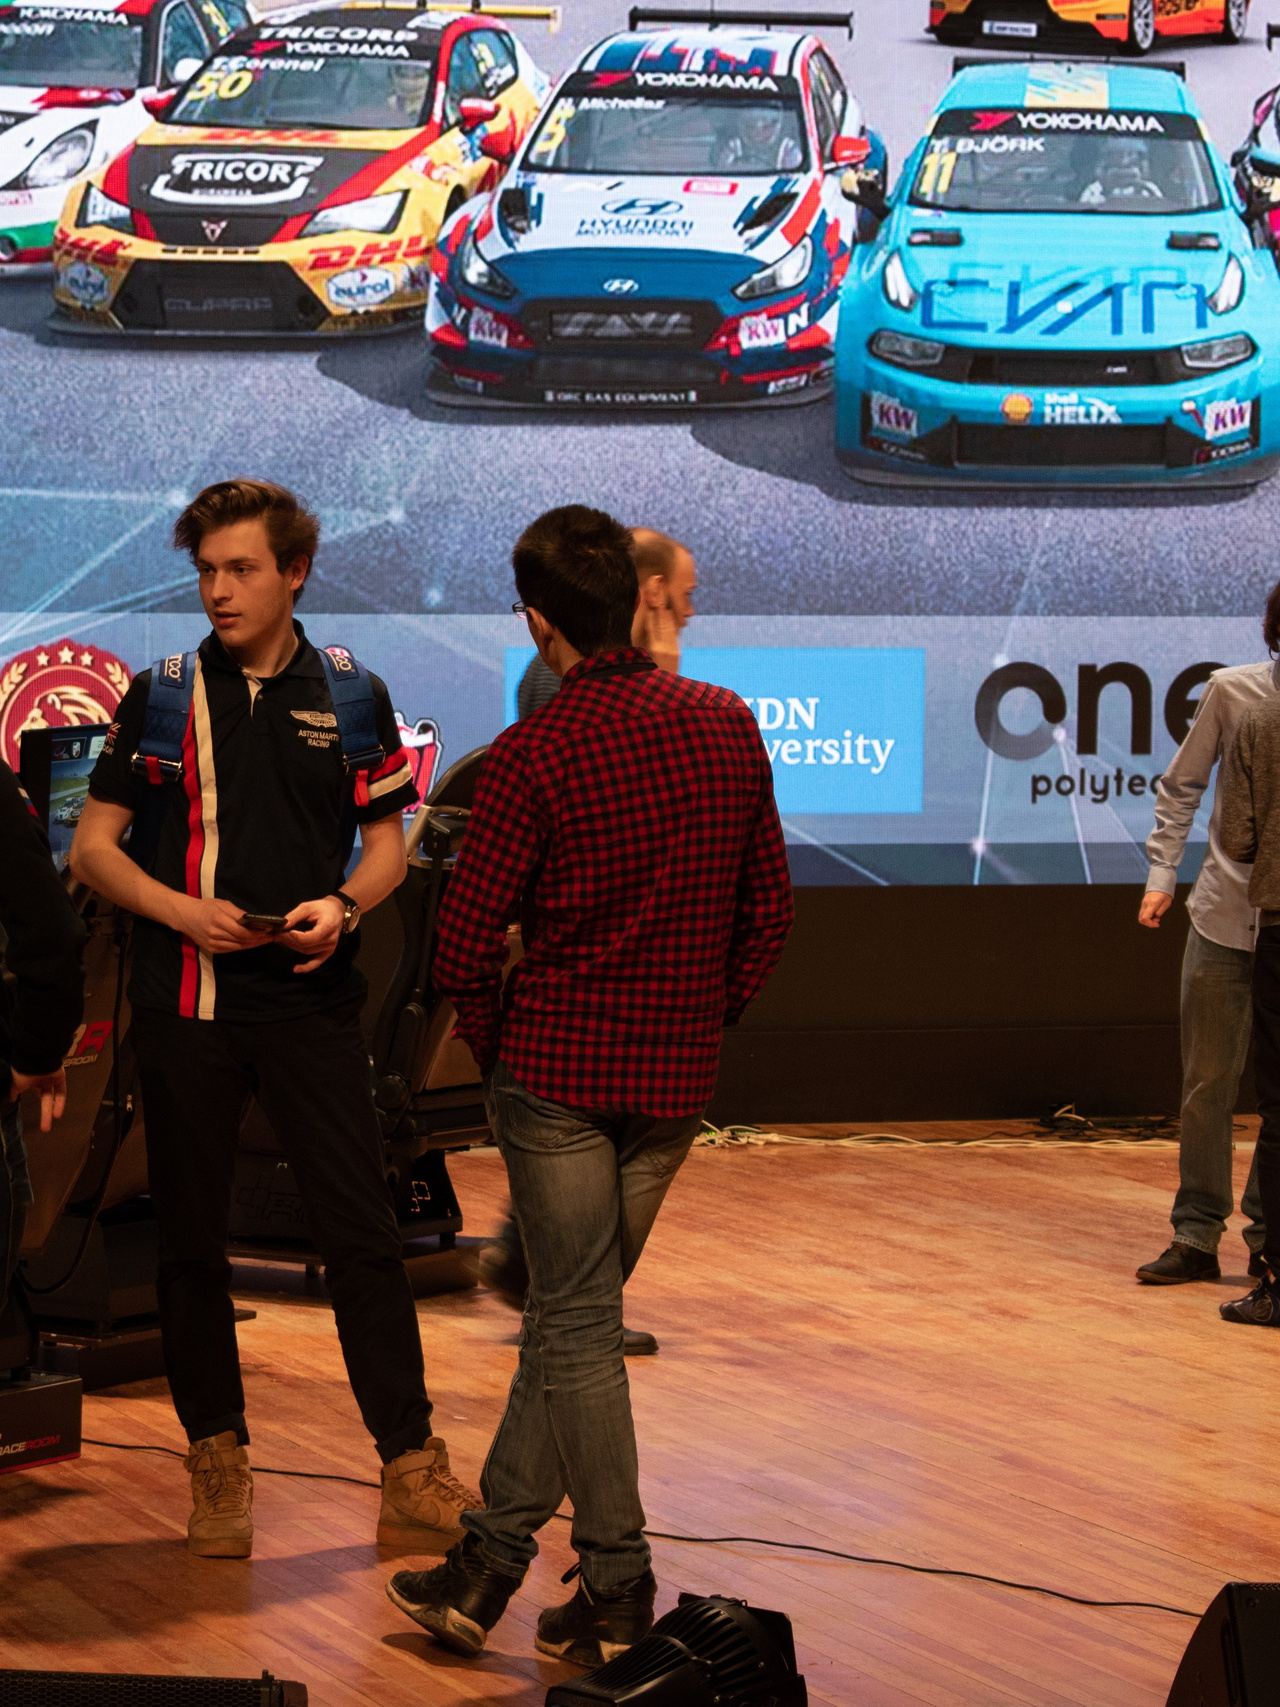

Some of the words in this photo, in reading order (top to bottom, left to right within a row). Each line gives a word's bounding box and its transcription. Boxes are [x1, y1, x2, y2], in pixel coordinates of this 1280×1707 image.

[19, 7, 128, 25] YOKOHAMA
[259, 26, 419, 42] TRICORP
[286, 41, 410, 58] YOKOHAMA
[187, 69, 255, 99] 50
[635, 72, 778, 93] YOKOHAMA
[1017, 114, 1165, 133] YOKOHAMA
[956, 136, 1045, 153] BJÖRK
[173, 159, 318, 184] TRICORP
[920, 152, 958, 194] 11
[580, 218, 694, 230] HYUNDAI
[308, 234, 432, 271] DHL
[746, 317, 781, 341] KW
[1044, 392, 1079, 405] Shell
[879, 404, 914, 430] KW
[1044, 405, 1123, 424] HELIX
[1214, 405, 1247, 431] KW
[298, 729, 319, 739] ASTON
[319, 732, 340, 742] MARTI
[308, 738, 331, 749] RACING
[763, 730, 895, 774] versity
[1031, 767, 1164, 804] polytec
